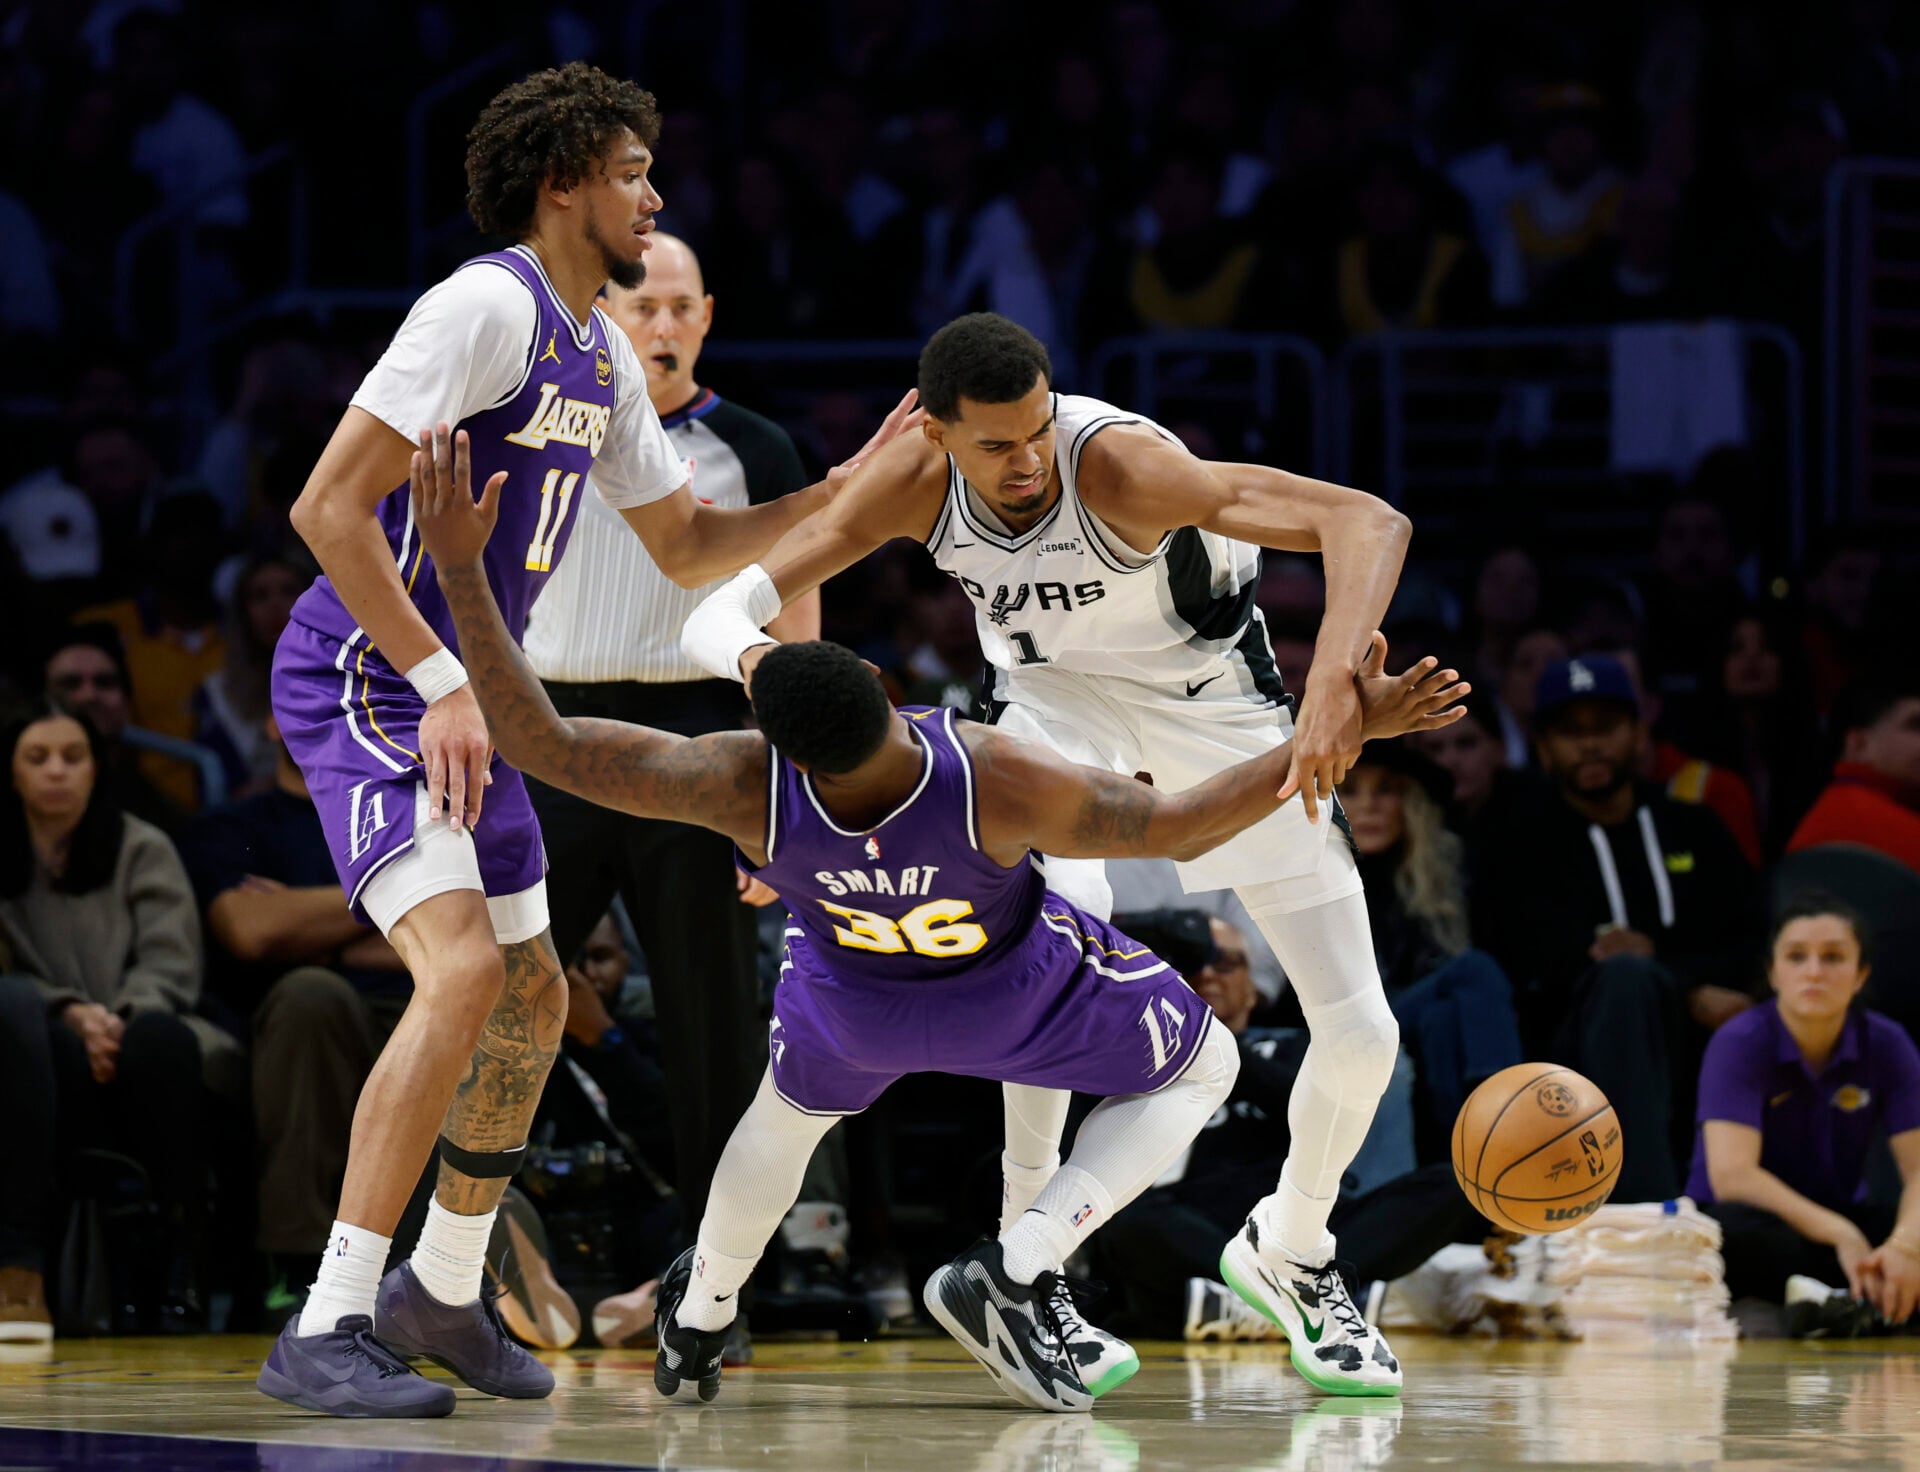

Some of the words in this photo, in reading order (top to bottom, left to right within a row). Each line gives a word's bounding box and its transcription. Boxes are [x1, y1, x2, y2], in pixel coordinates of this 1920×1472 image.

[504, 382, 611, 458] LAKERS
[525, 469, 580, 572] 11
[1041, 542, 1077, 552] LEDGER
[946, 569, 1106, 627] PURS
[1006, 630, 1050, 666] 1
[344, 779, 389, 867] LA
[815, 865, 940, 896] SMART
[815, 898, 989, 958] 36
[1139, 995, 1187, 1078] LA
